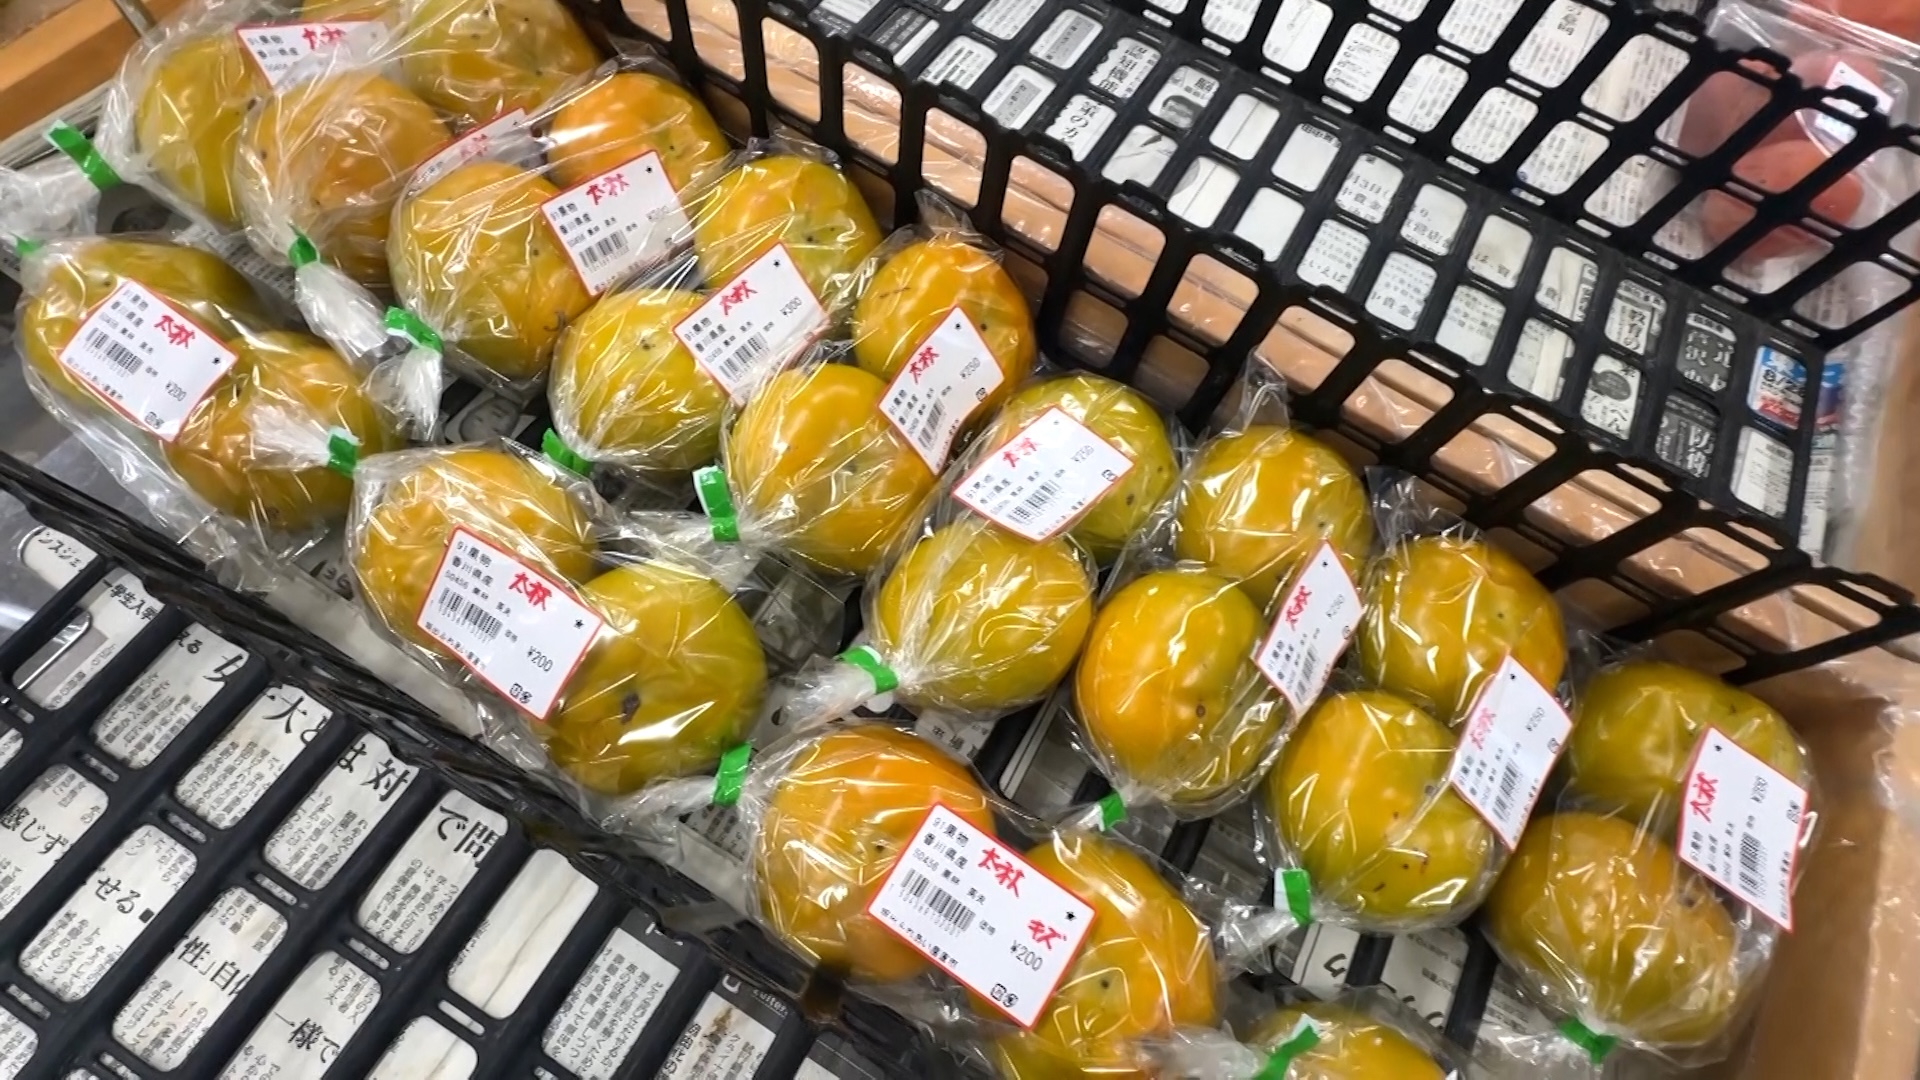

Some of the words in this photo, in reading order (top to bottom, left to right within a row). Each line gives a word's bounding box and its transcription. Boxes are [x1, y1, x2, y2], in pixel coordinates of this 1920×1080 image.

[509, 572, 553, 611] 太秋
[526, 645, 553, 672] ¥200
[932, 817, 969, 847] 91果物
[923, 834, 969, 869] 香川県産
[978, 848, 1026, 898] 太秋
[1028, 919, 1068, 950] キズ
[1010, 940, 1043, 971] ¥200
